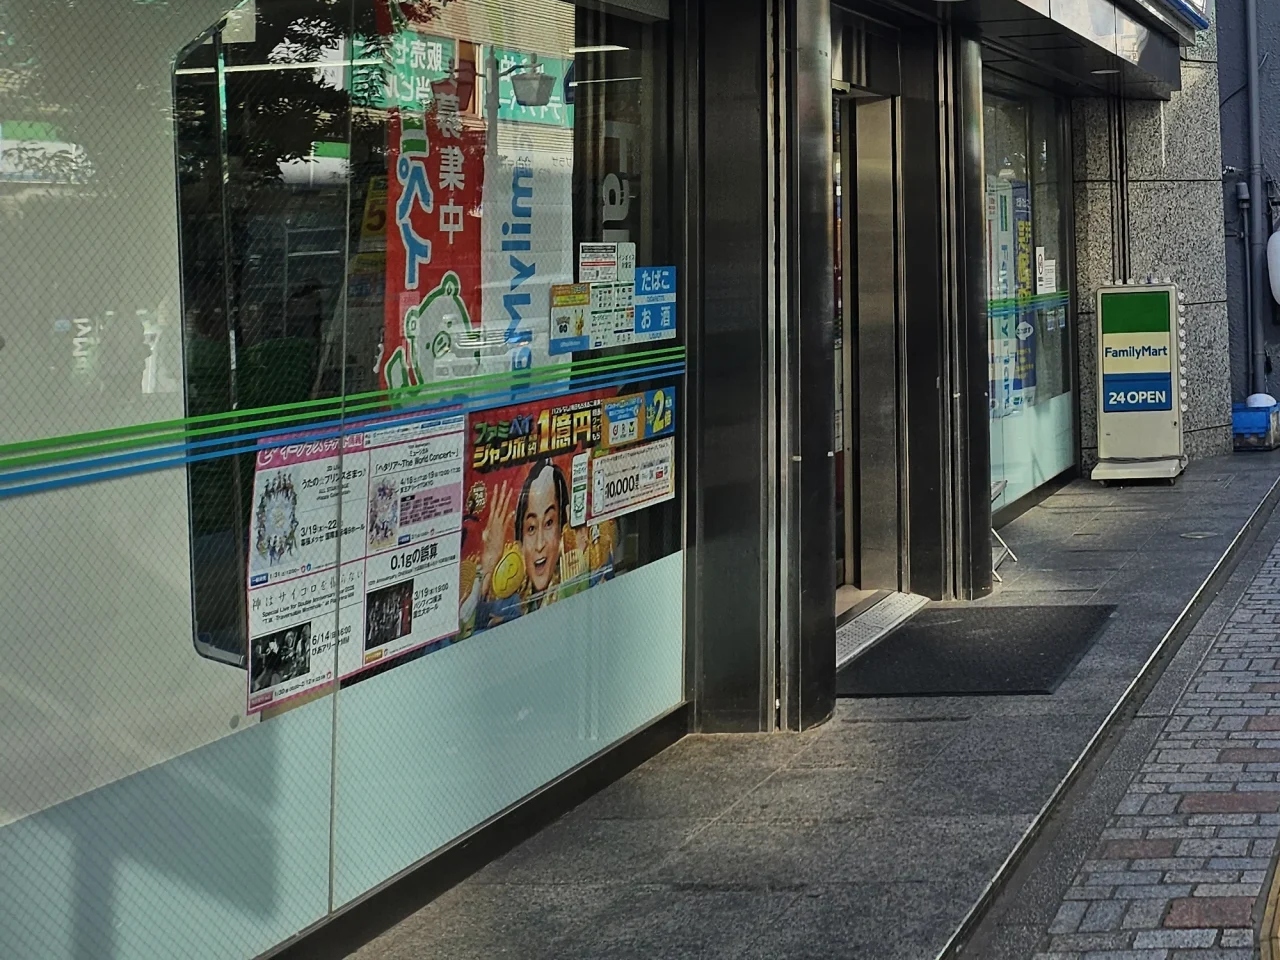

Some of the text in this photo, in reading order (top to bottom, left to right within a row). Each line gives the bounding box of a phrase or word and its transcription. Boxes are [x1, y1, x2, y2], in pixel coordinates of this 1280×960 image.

[641, 269, 670, 291] たばこ
[1105, 345, 1168, 359] FamilyMart
